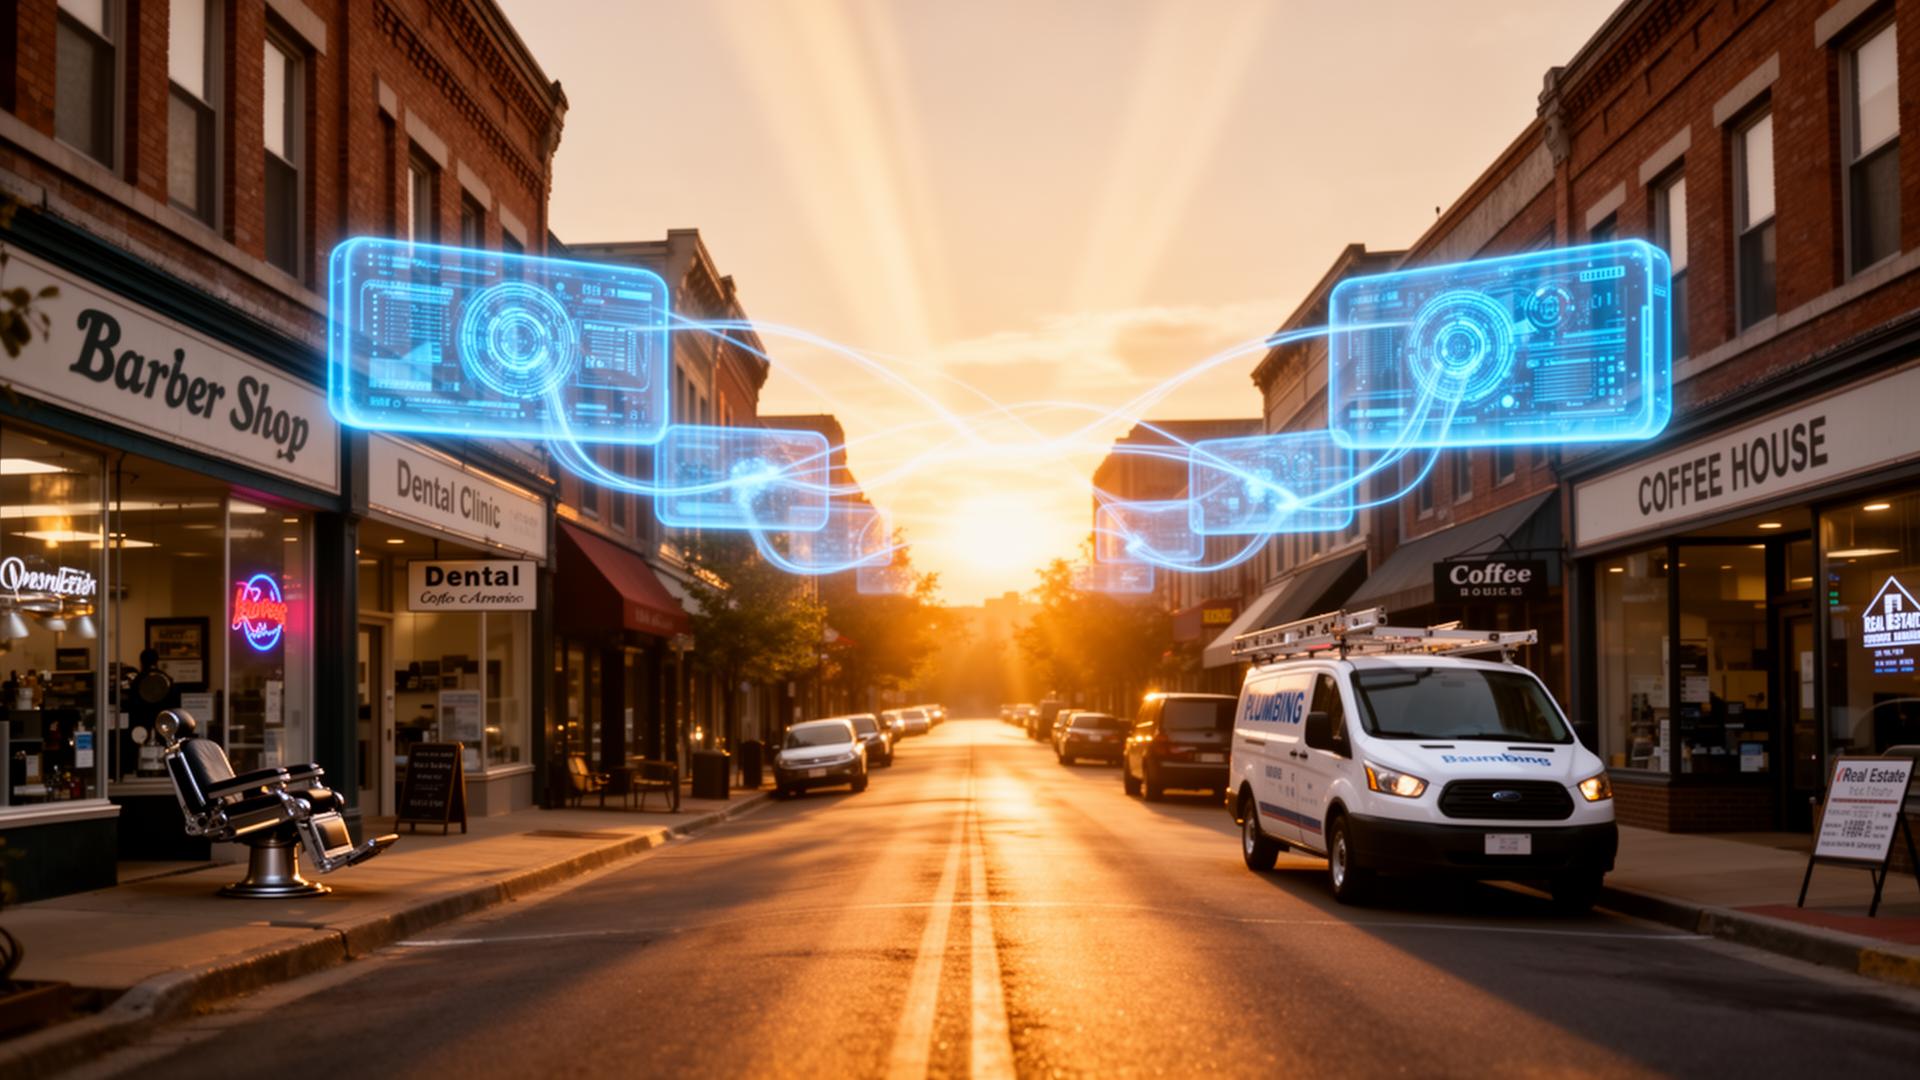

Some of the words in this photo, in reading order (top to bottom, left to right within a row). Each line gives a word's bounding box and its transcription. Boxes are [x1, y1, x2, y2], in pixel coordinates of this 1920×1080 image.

[69, 308, 225, 418] Barber
[230, 376, 310, 463] Shop
[1639, 452, 1723, 516] COFFEE
[1731, 416, 1828, 491] HOUSE
[397, 458, 455, 514] Dental
[460, 486, 501, 529] Clinic
[425, 566, 519, 587] Dental
[1450, 563, 1532, 585] Coffee
[1864, 615, 1885, 632] REAL
[1244, 691, 1304, 725] PLUMBING
[1843, 767, 1868, 783] Real
[1869, 768, 1906, 784] Estate
